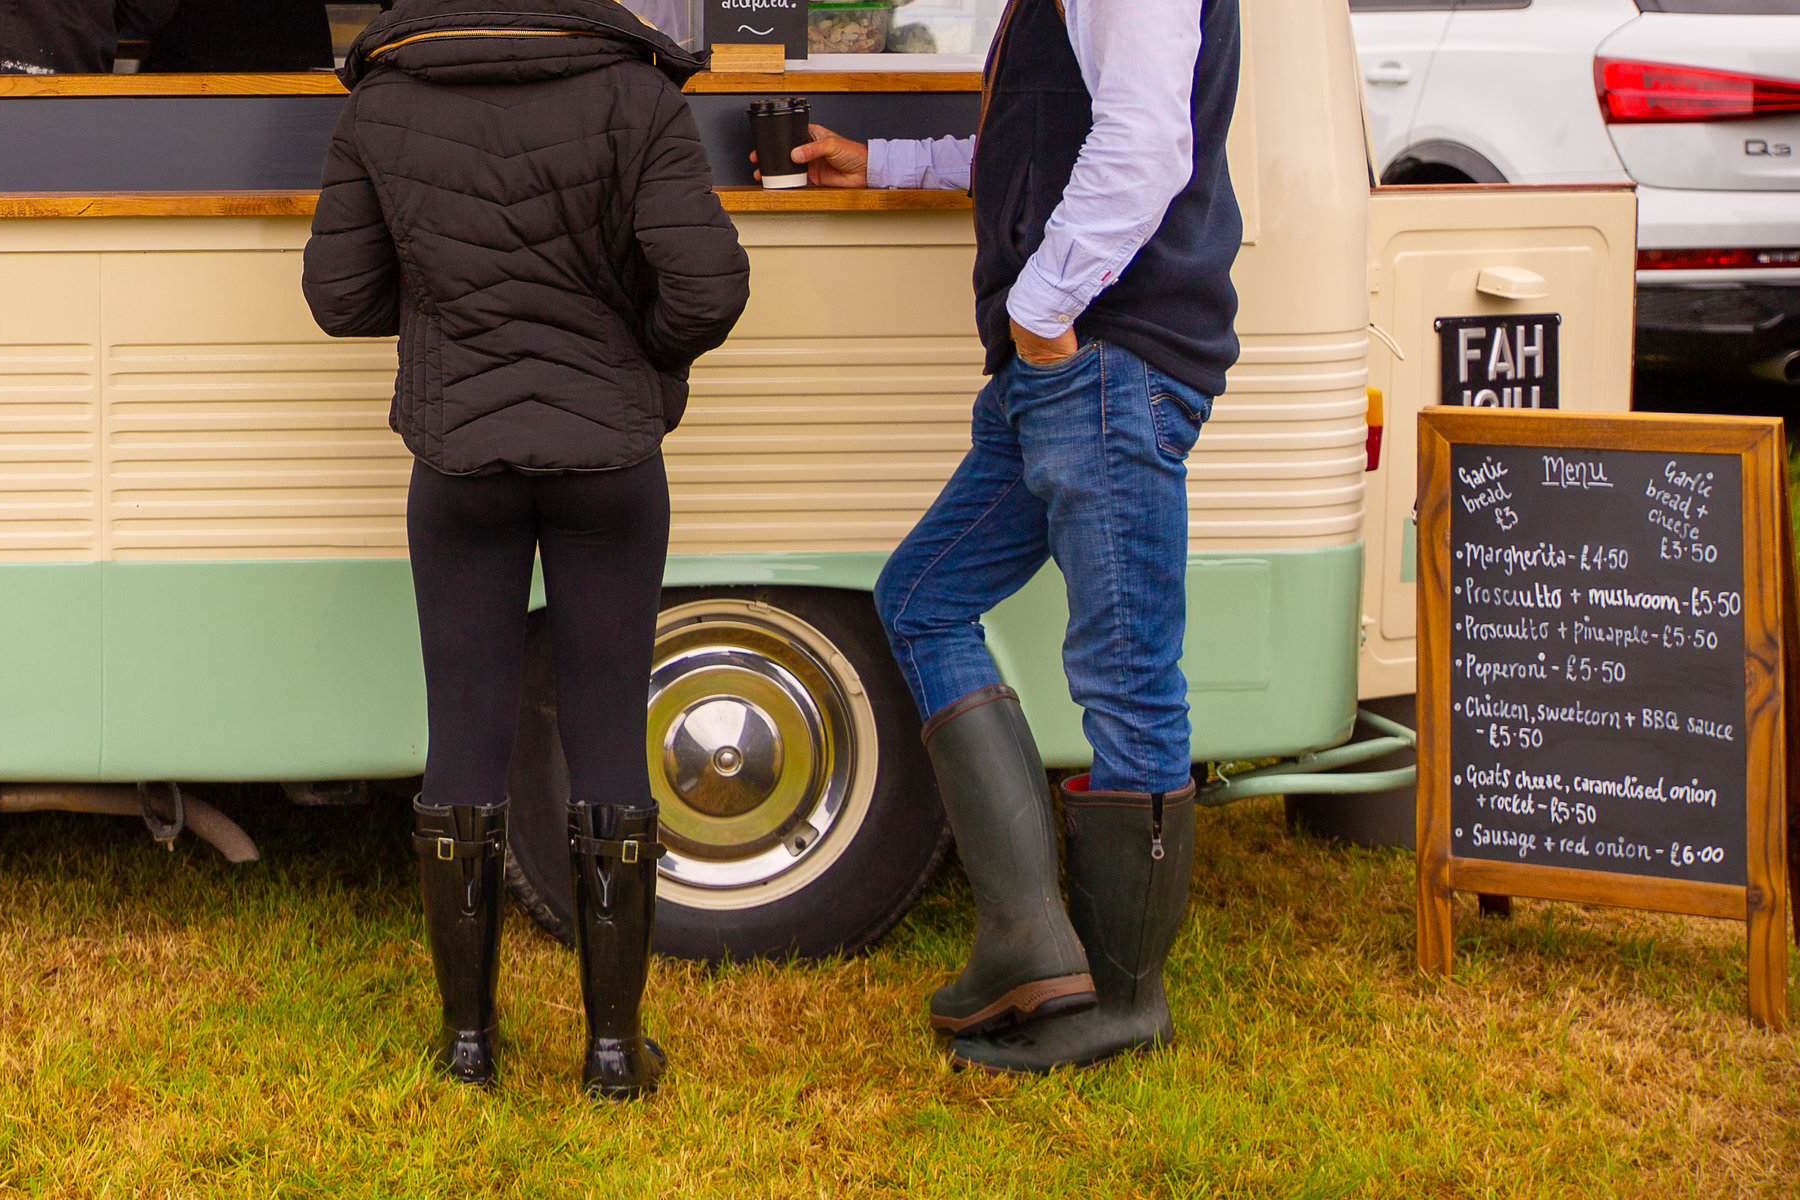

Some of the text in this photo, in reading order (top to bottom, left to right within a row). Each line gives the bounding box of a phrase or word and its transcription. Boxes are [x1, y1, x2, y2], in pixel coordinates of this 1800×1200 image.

[1744, 139, 1792, 158] Q3
[1458, 323, 1544, 384] FAH
[1458, 456, 1509, 490] Garlic
[1541, 455, 1608, 490] Menu
[1665, 460, 1714, 498] Garlic
[1461, 482, 1512, 514] bread
[1645, 478, 1708, 519] bread +
[1494, 506, 1518, 532] £3
[1648, 509, 1699, 540] cheese
[1580, 544, 1628, 571] £4.50
[1660, 536, 1718, 563] £3.50
[1570, 590, 1581, 604] +
[1557, 622, 1568, 639] +
[1466, 652, 1547, 685] Pepperoni
[1642, 708, 1680, 731] BBQ
[1687, 717, 1734, 742] sauce
[1466, 763, 1718, 808] Goats cheese, caramelised onion
[1472, 823, 1537, 858] Sausage
[1544, 836, 1556, 853] +
[1560, 835, 1590, 857] red
[1595, 837, 1652, 861] onion
[1669, 842, 1725, 867] £6.00
